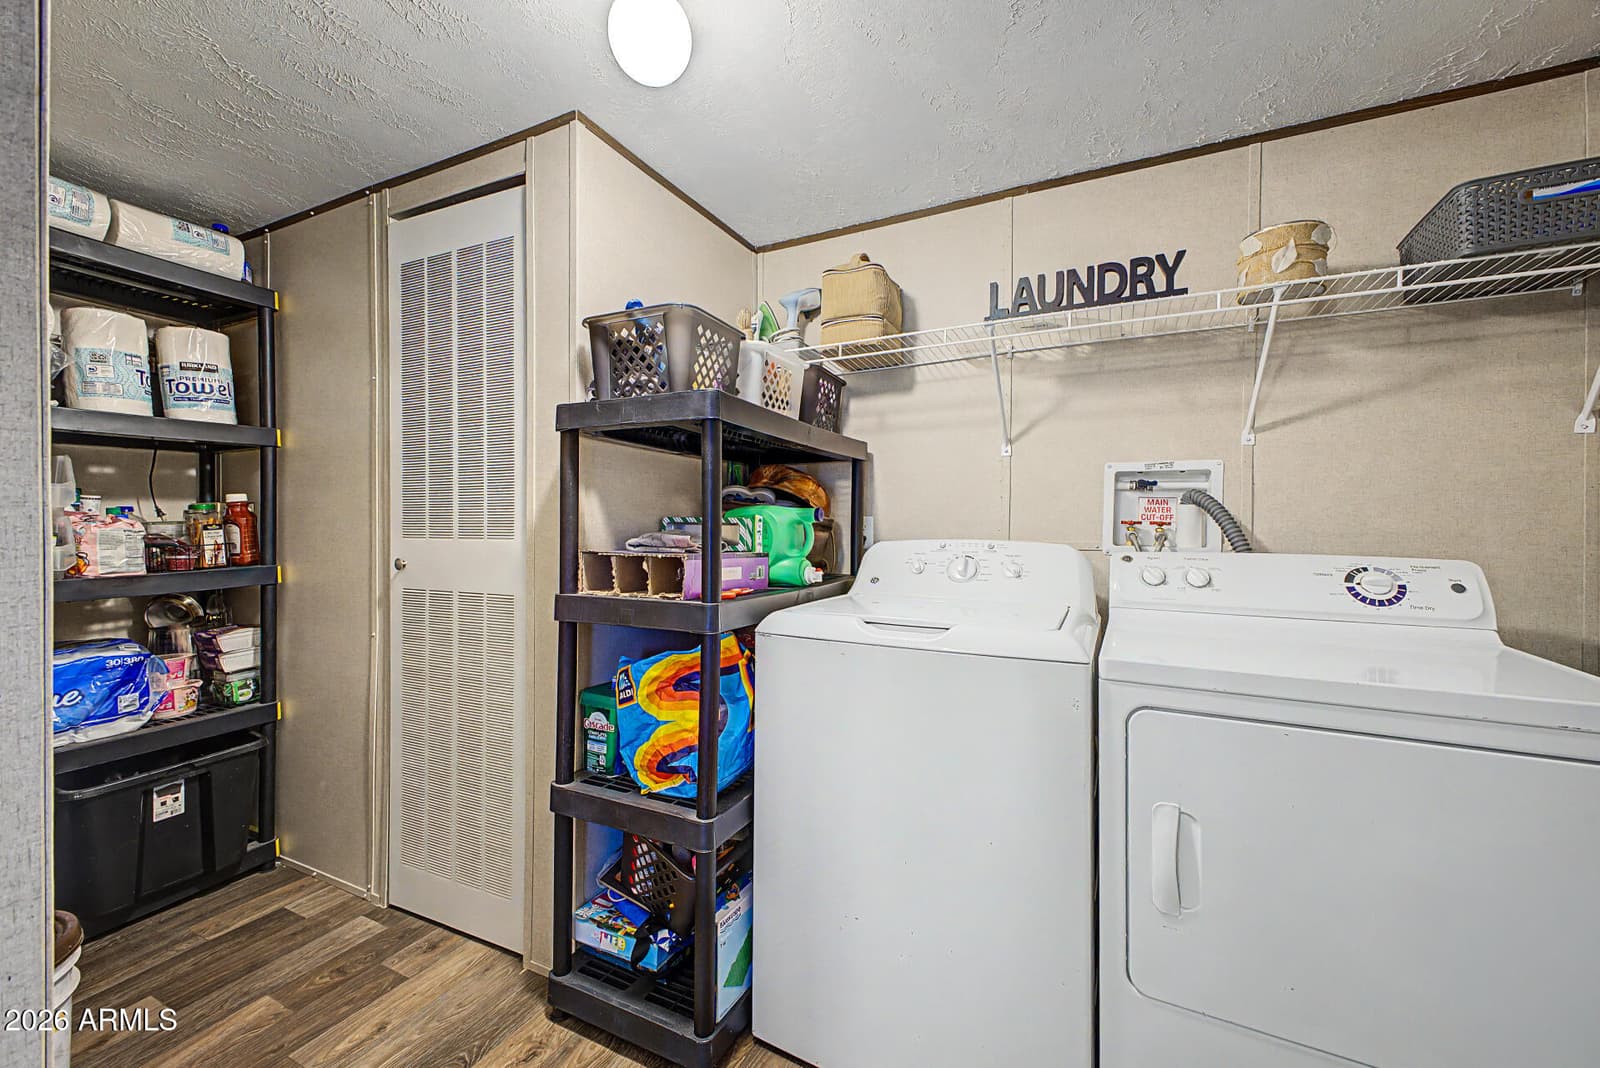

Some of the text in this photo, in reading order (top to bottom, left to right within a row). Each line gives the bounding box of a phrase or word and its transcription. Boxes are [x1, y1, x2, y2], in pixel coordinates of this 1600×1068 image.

[985, 249, 1188, 321] LAUNDRY
[165, 378, 232, 398] Towel
[1141, 513, 1174, 521] CUT-OFF
[619, 687, 634, 700] ALDI
